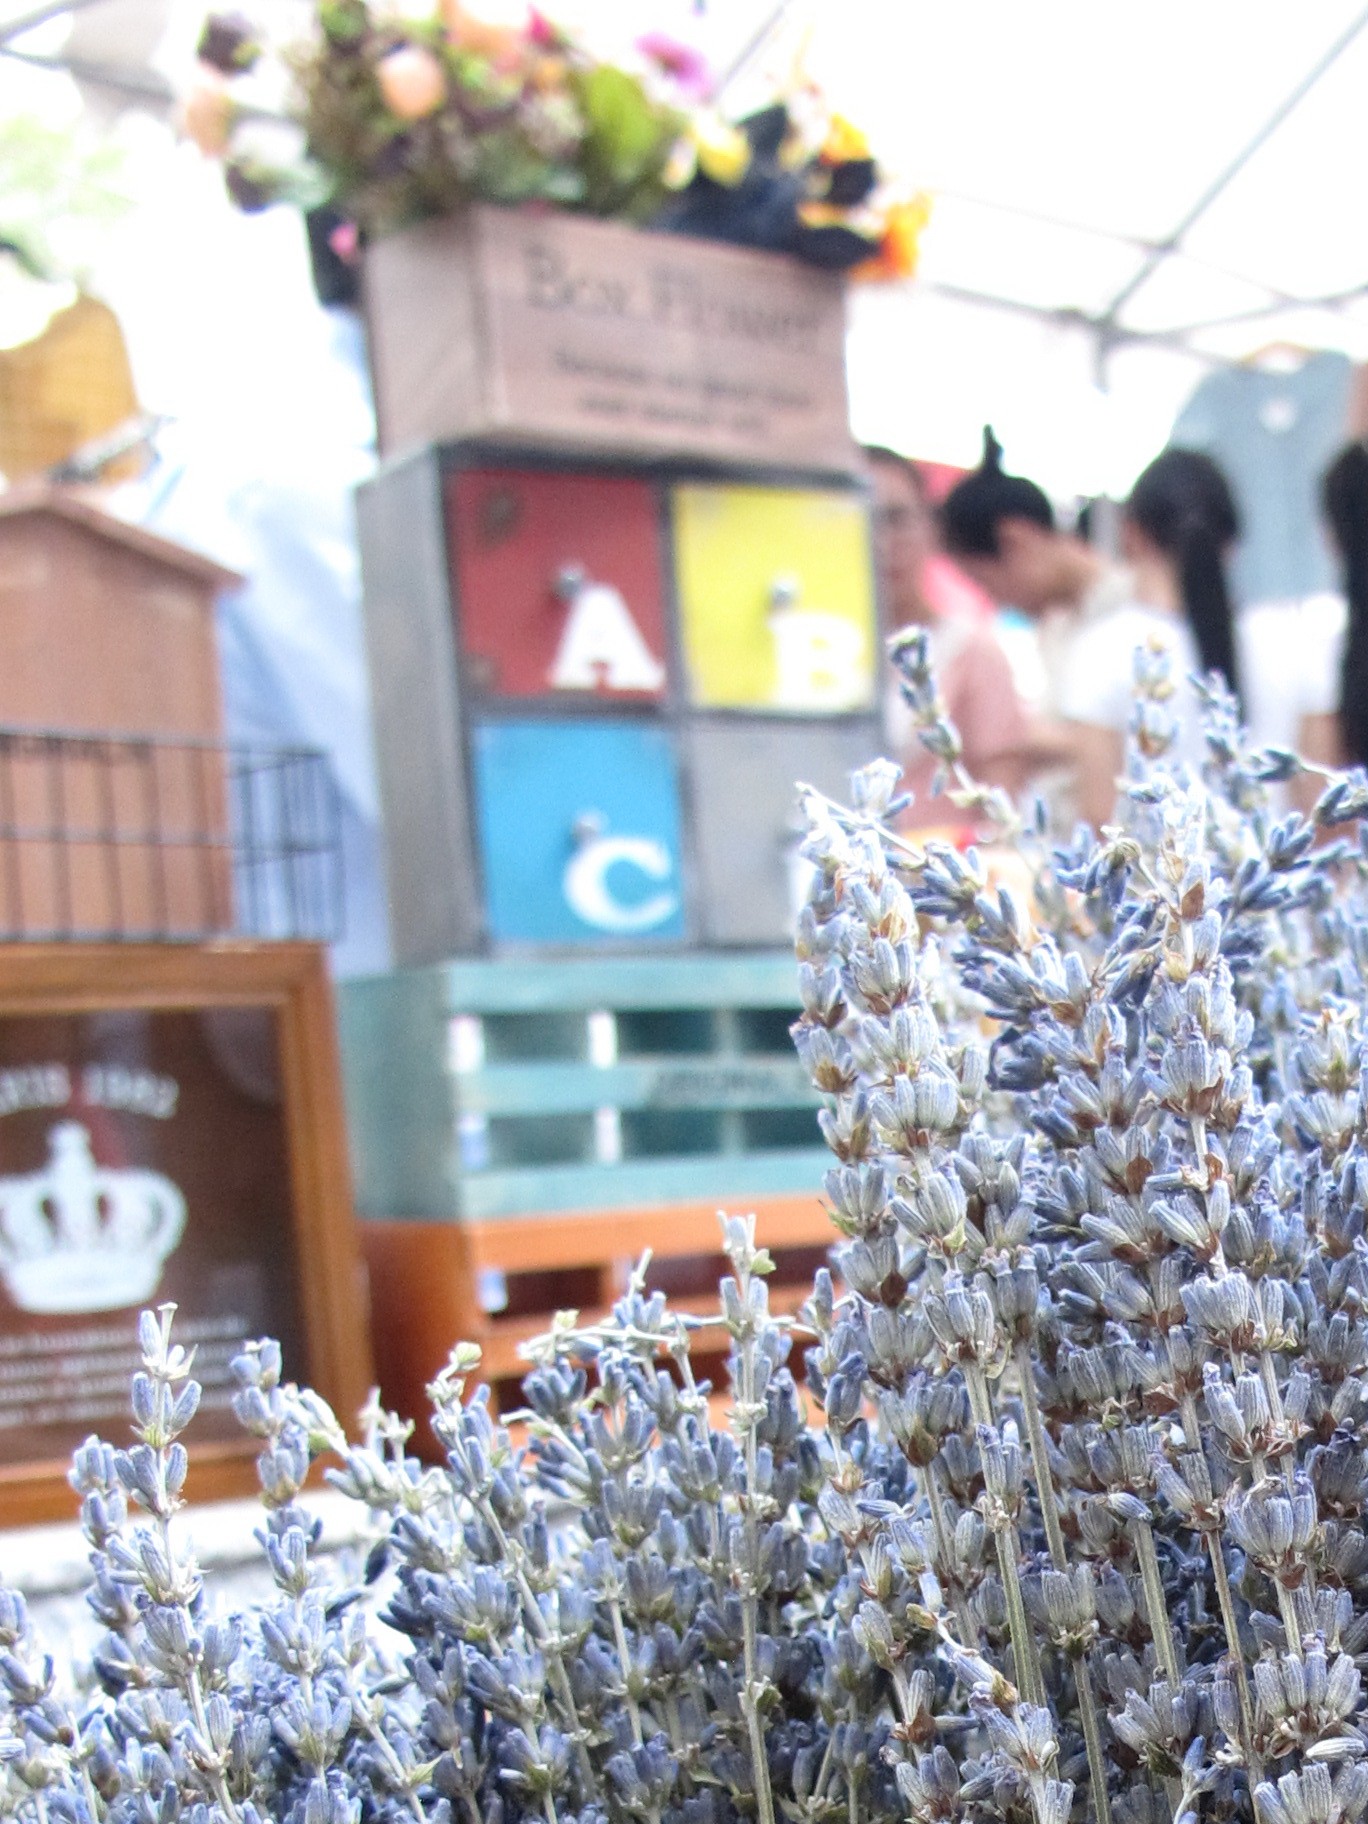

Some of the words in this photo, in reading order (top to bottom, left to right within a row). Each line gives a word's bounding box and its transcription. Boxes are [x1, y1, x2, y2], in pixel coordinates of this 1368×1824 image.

[547, 582, 667, 693] A
[768, 608, 866, 712] B
[562, 836, 678, 934] C
